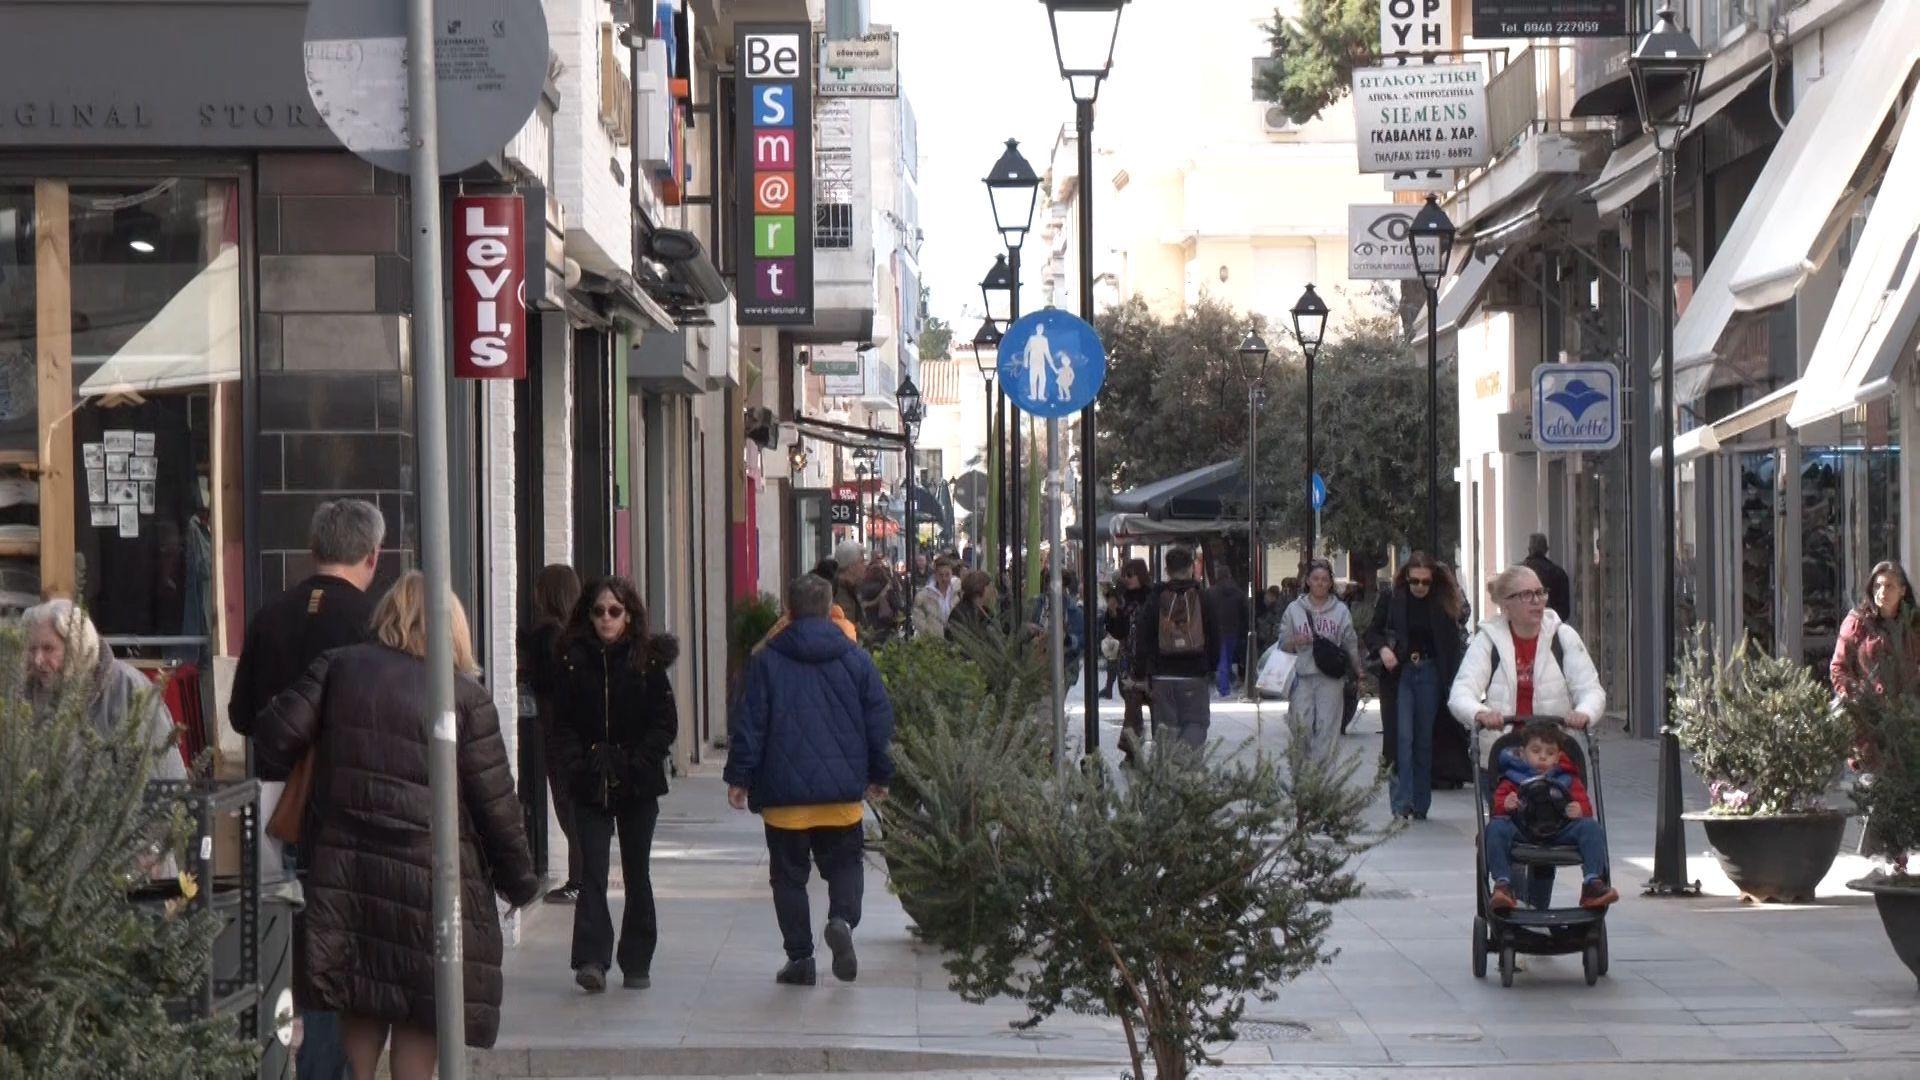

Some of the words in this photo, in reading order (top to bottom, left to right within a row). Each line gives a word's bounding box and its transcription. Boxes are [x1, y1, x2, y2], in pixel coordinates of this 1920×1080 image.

[747, 37, 797, 75] Be
[1380, 103, 1467, 124] SIEMENS
[1371, 128, 1432, 143] ΓΚΑΒΑΛΗΣ
[1436, 129, 1448, 141] Δ.
[1451, 127, 1477, 140] ΧΑΡ.
[1415, 149, 1440, 161] 22210
